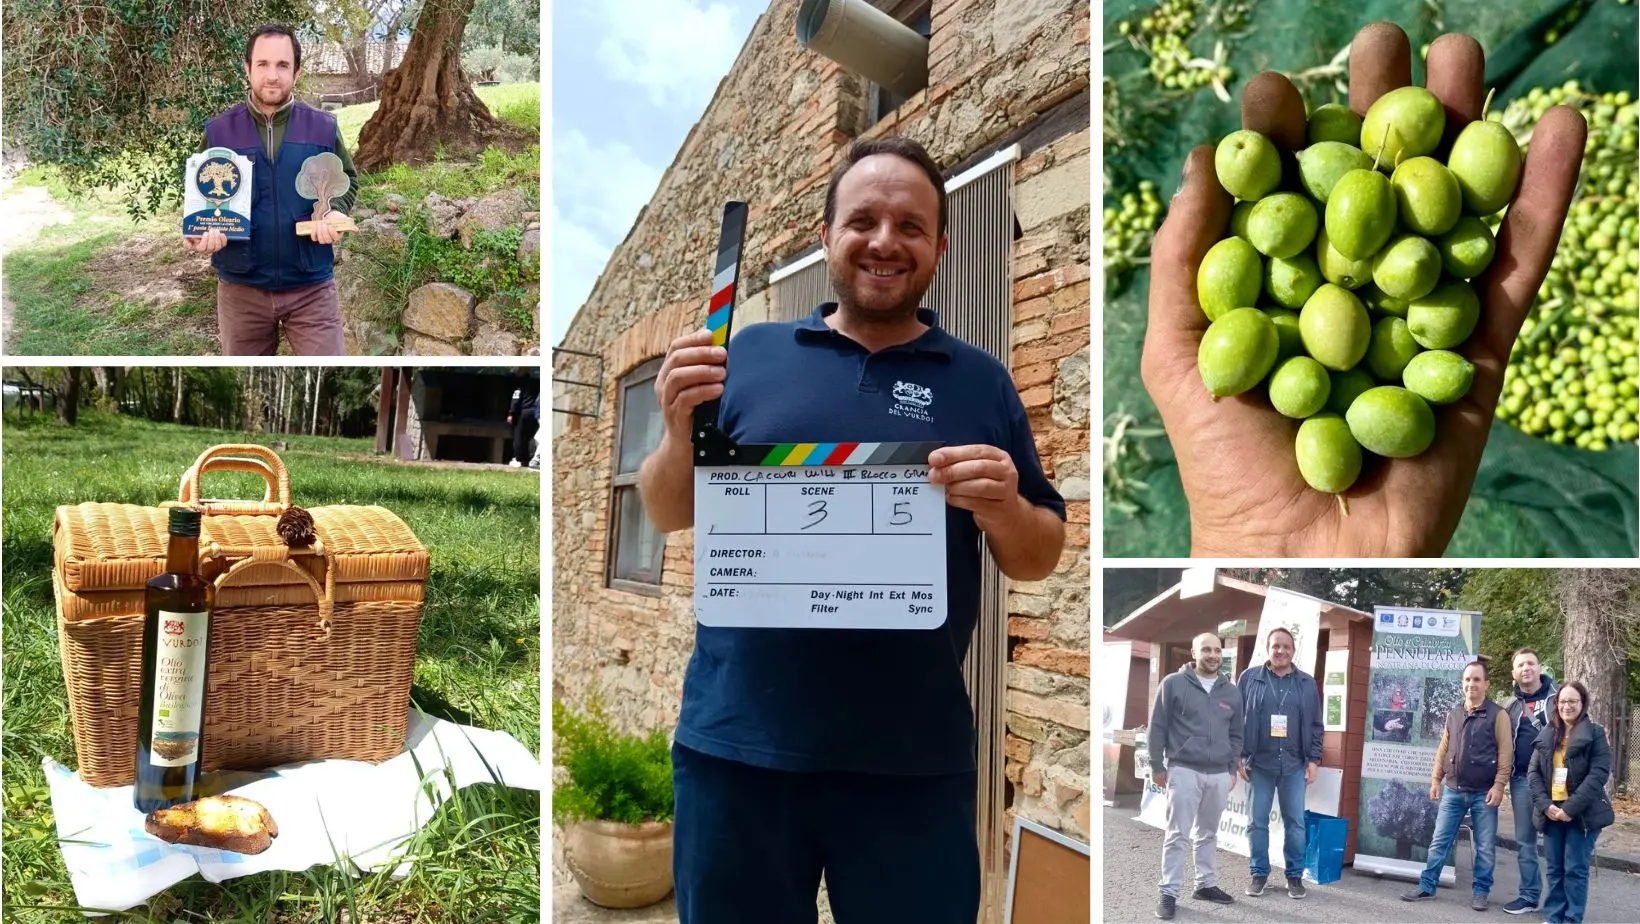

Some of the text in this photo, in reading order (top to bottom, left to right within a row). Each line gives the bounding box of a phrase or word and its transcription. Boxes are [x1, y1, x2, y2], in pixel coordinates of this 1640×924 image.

[888, 408, 902, 416] DEL
[710, 472, 741, 481] PROD.
[725, 487, 751, 496] ROLL
[801, 487, 835, 496] SCENE
[892, 486, 919, 495] TAKE
[801, 500, 828, 529] 3
[890, 502, 912, 526] 5
[710, 549, 766, 558] DIRECTOR:
[710, 568, 757, 577] CAMERA:
[710, 588, 740, 597] DATE:
[869, 591, 884, 600] Int
[889, 591, 906, 600] Ext
[911, 591, 933, 600] Mos
[811, 604, 839, 613] Filter
[908, 605, 933, 614] Sync
[1385, 635, 1403, 646] Olio
[1376, 644, 1466, 661] PENNULARA
[162, 657, 183, 667] Olio
[160, 667, 185, 676] extra
[160, 682, 169, 690] di
[160, 691, 186, 700] Oliva
